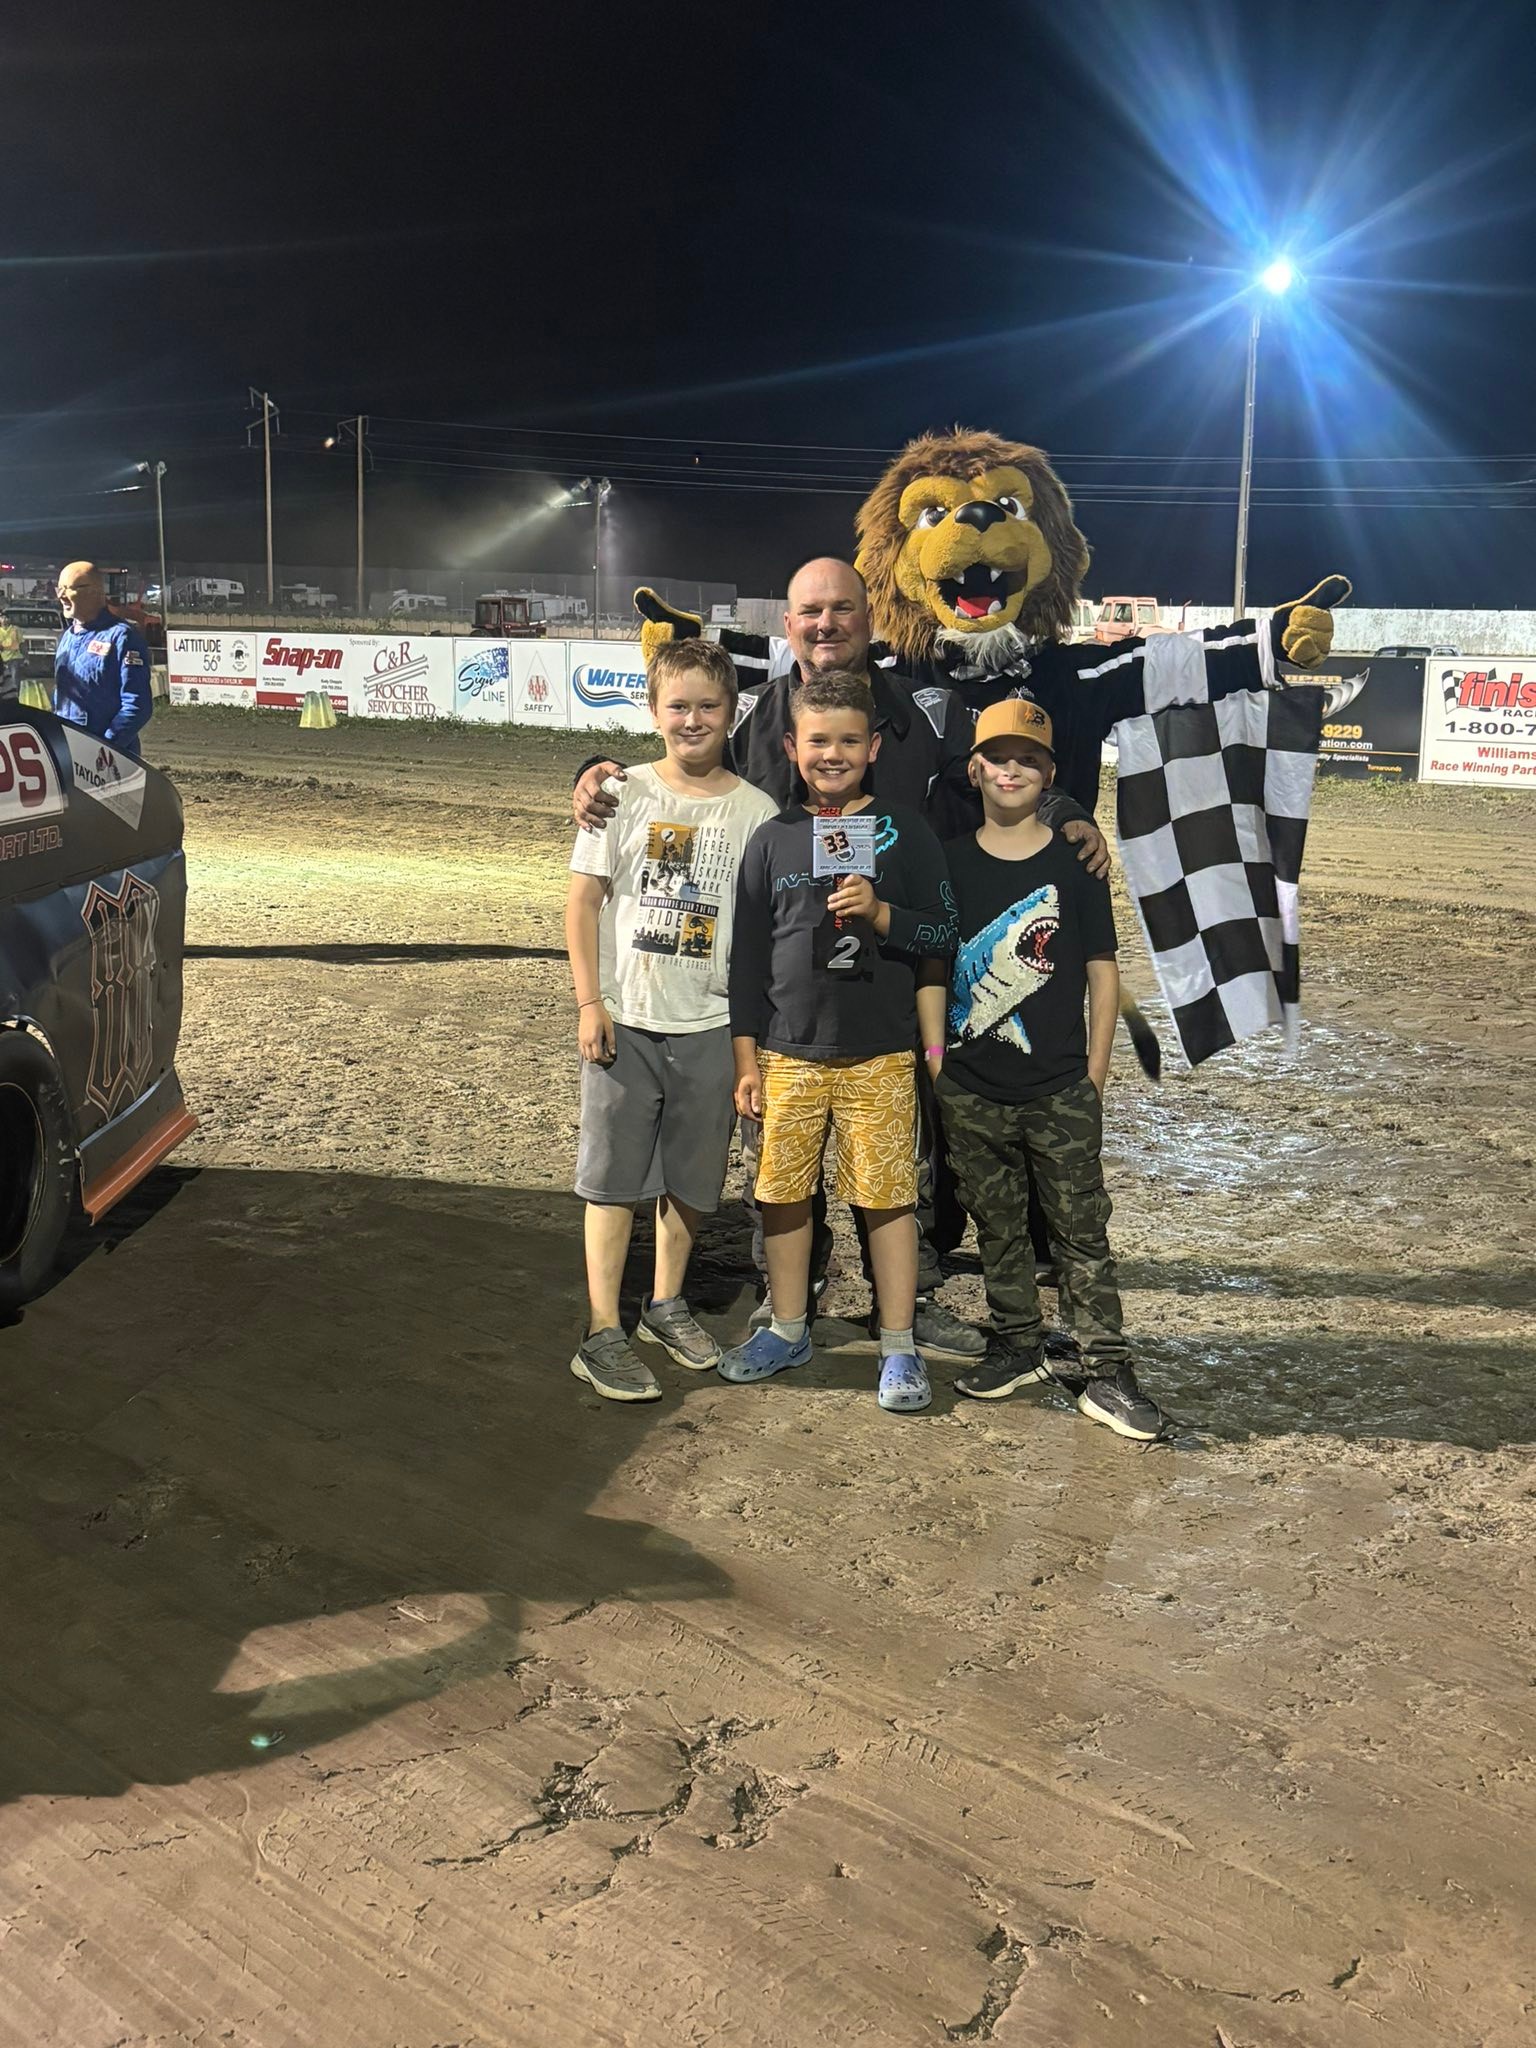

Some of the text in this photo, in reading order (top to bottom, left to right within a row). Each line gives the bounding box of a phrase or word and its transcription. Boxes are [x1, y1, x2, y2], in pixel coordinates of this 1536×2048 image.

[173, 638, 221, 653] LATTITUDE
[262, 637, 344, 676] Snap-on
[373, 641, 412, 674] C&R
[458, 662, 496, 697] Sign
[587, 668, 647, 689] WATER
[375, 684, 429, 701] KOCHER
[482, 691, 505, 702] LINE
[368, 699, 412, 715] SERVICES
[524, 703, 553, 712] SAFETY
[1503, 709, 1536, 718] RAC
[1319, 739, 1373, 749] ation.com
[1430, 760, 1459, 771] Race
[1462, 761, 1509, 776] Winning
[705, 827, 725, 839] NYC
[704, 840, 730, 853] FREE
[824, 831, 850, 854] 33
[701, 853, 735, 868] STYLE
[698, 867, 731, 882] SKATE
[647, 908, 684, 928] RIDE
[827, 936, 861, 969] 2
